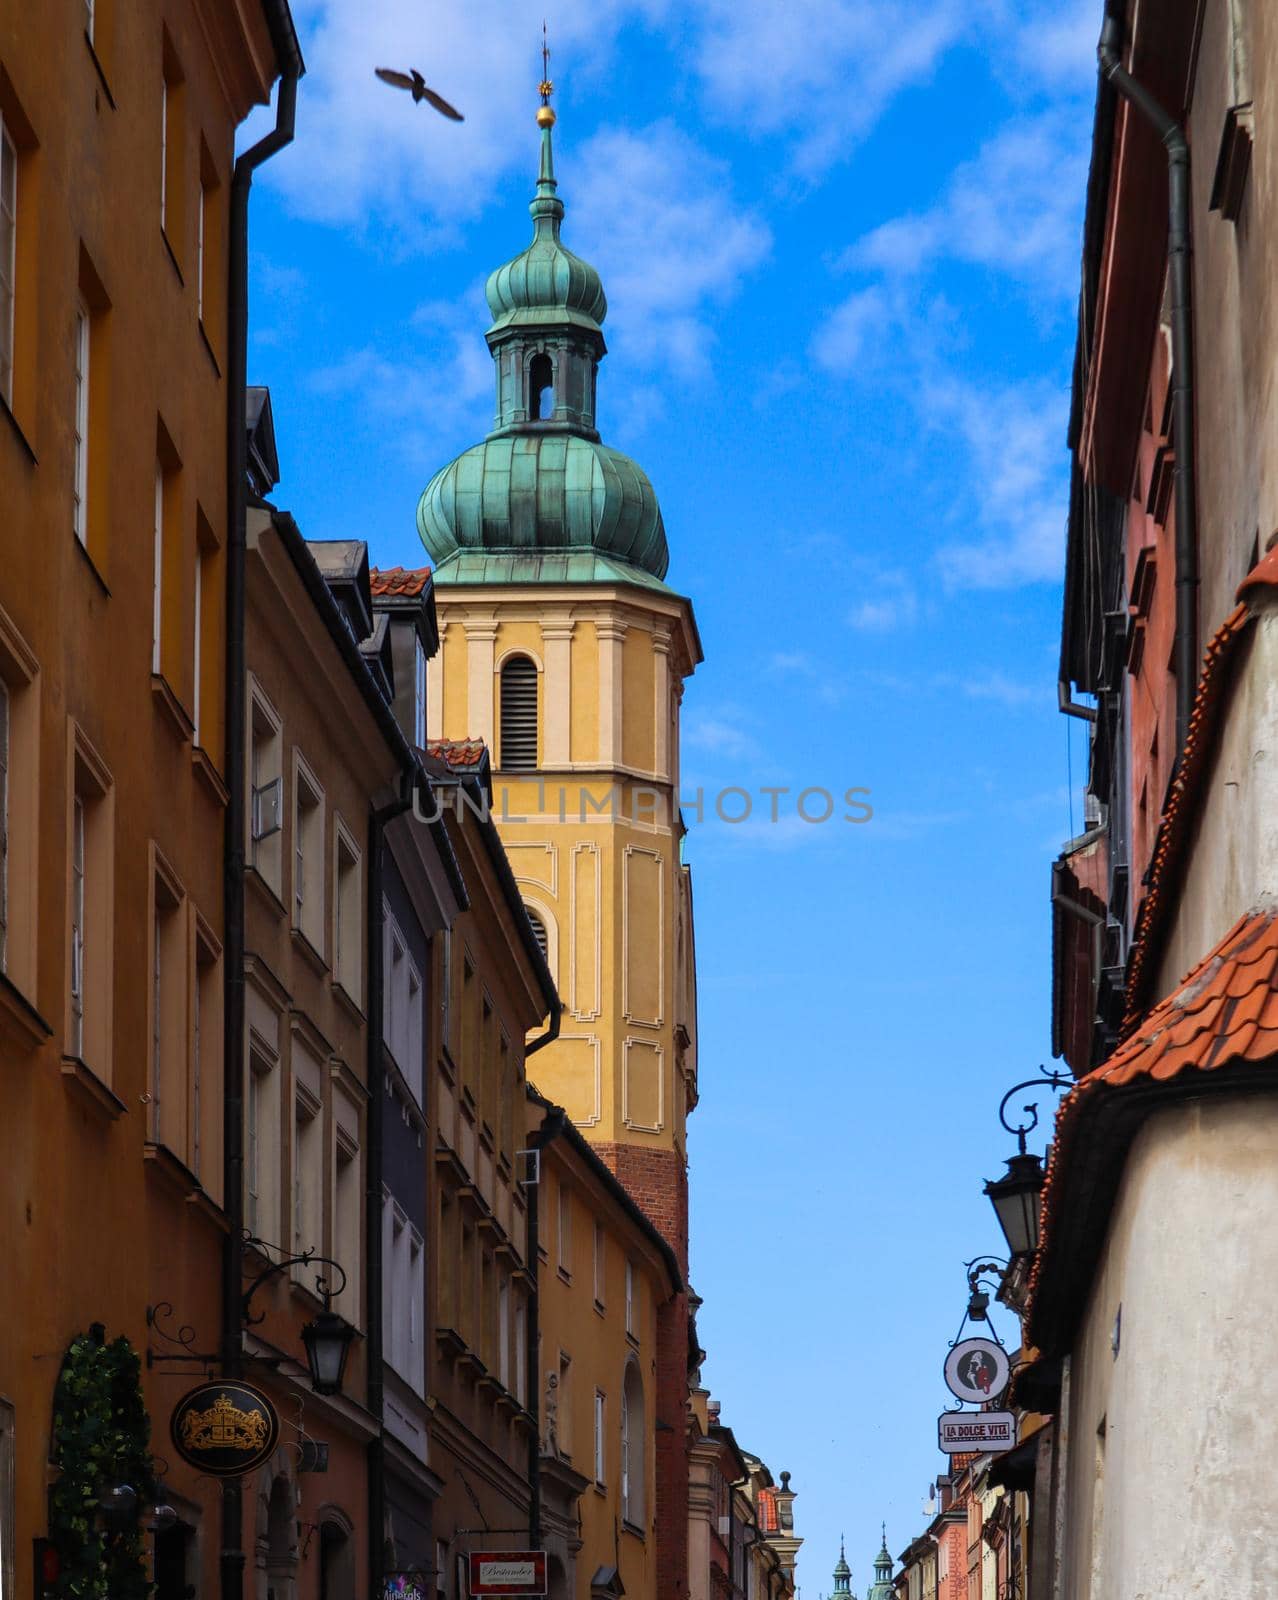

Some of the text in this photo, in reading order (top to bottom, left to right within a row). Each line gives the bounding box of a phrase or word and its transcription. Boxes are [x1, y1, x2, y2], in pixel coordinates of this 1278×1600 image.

[947, 1425, 1007, 1436] LA DOLCE VITA
